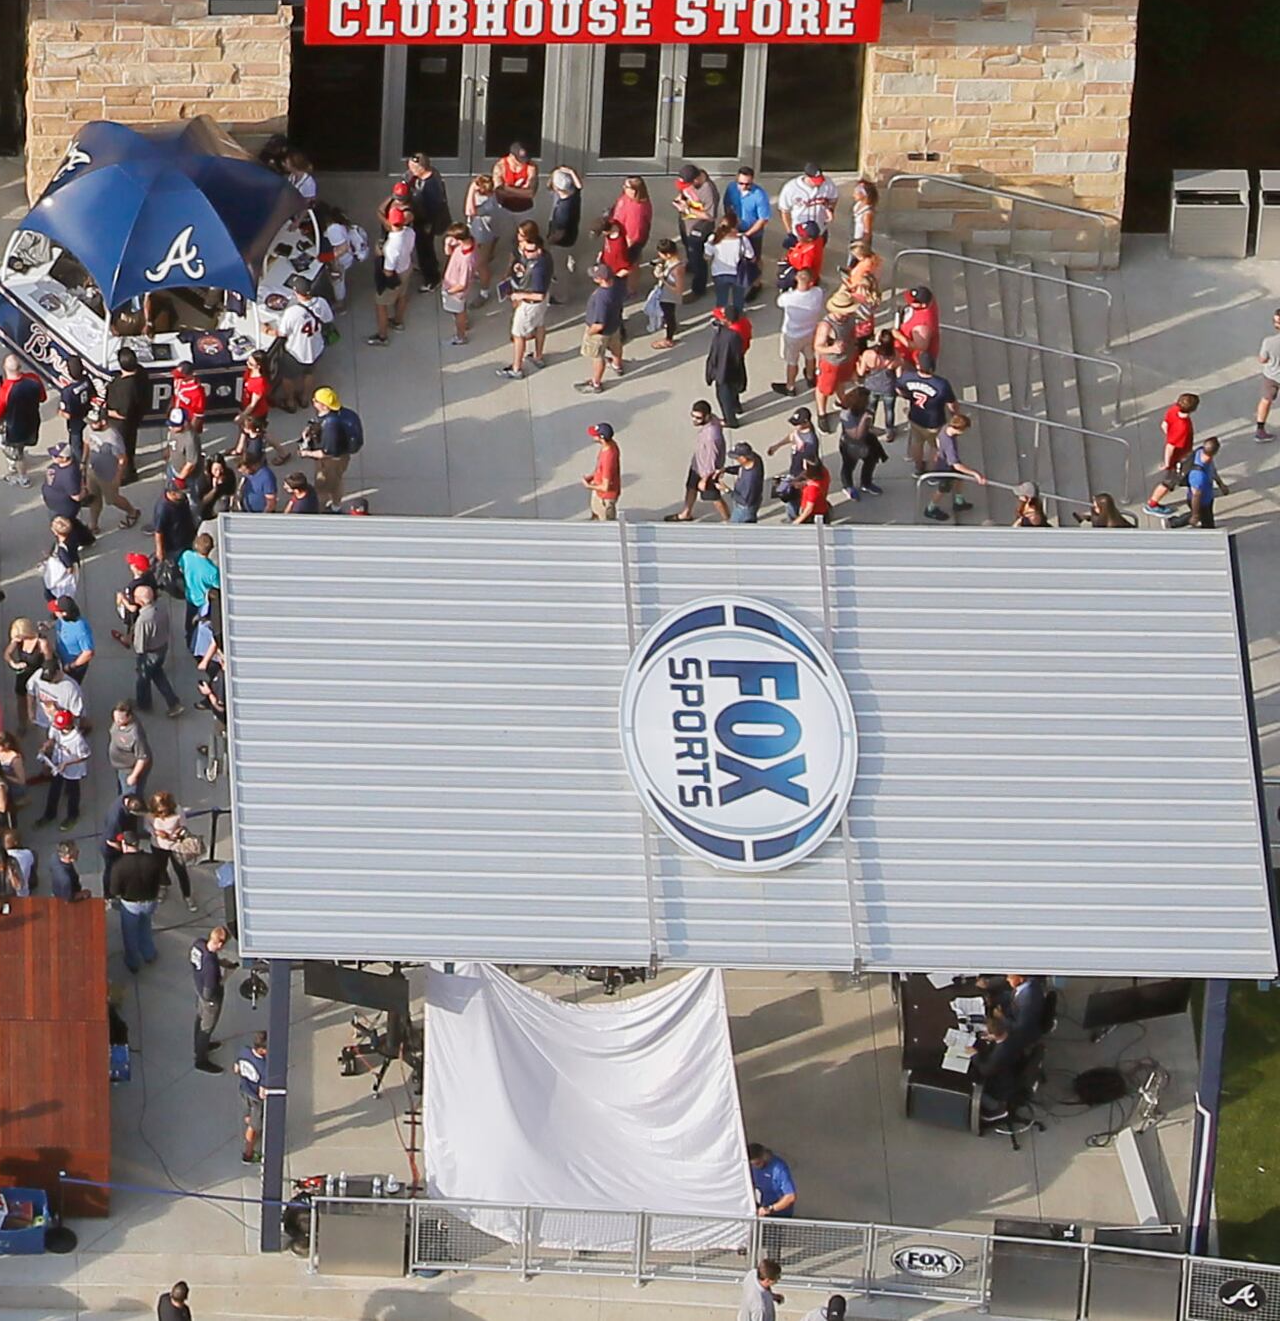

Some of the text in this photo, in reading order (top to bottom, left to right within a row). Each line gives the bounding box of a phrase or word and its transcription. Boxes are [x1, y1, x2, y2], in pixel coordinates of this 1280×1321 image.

[144, 224, 206, 283] A
[913, 391, 928, 409] 7
[668, 657, 714, 808] SPORTS
[708, 659, 810, 808] FOX
[907, 1251, 947, 1267] FOX
